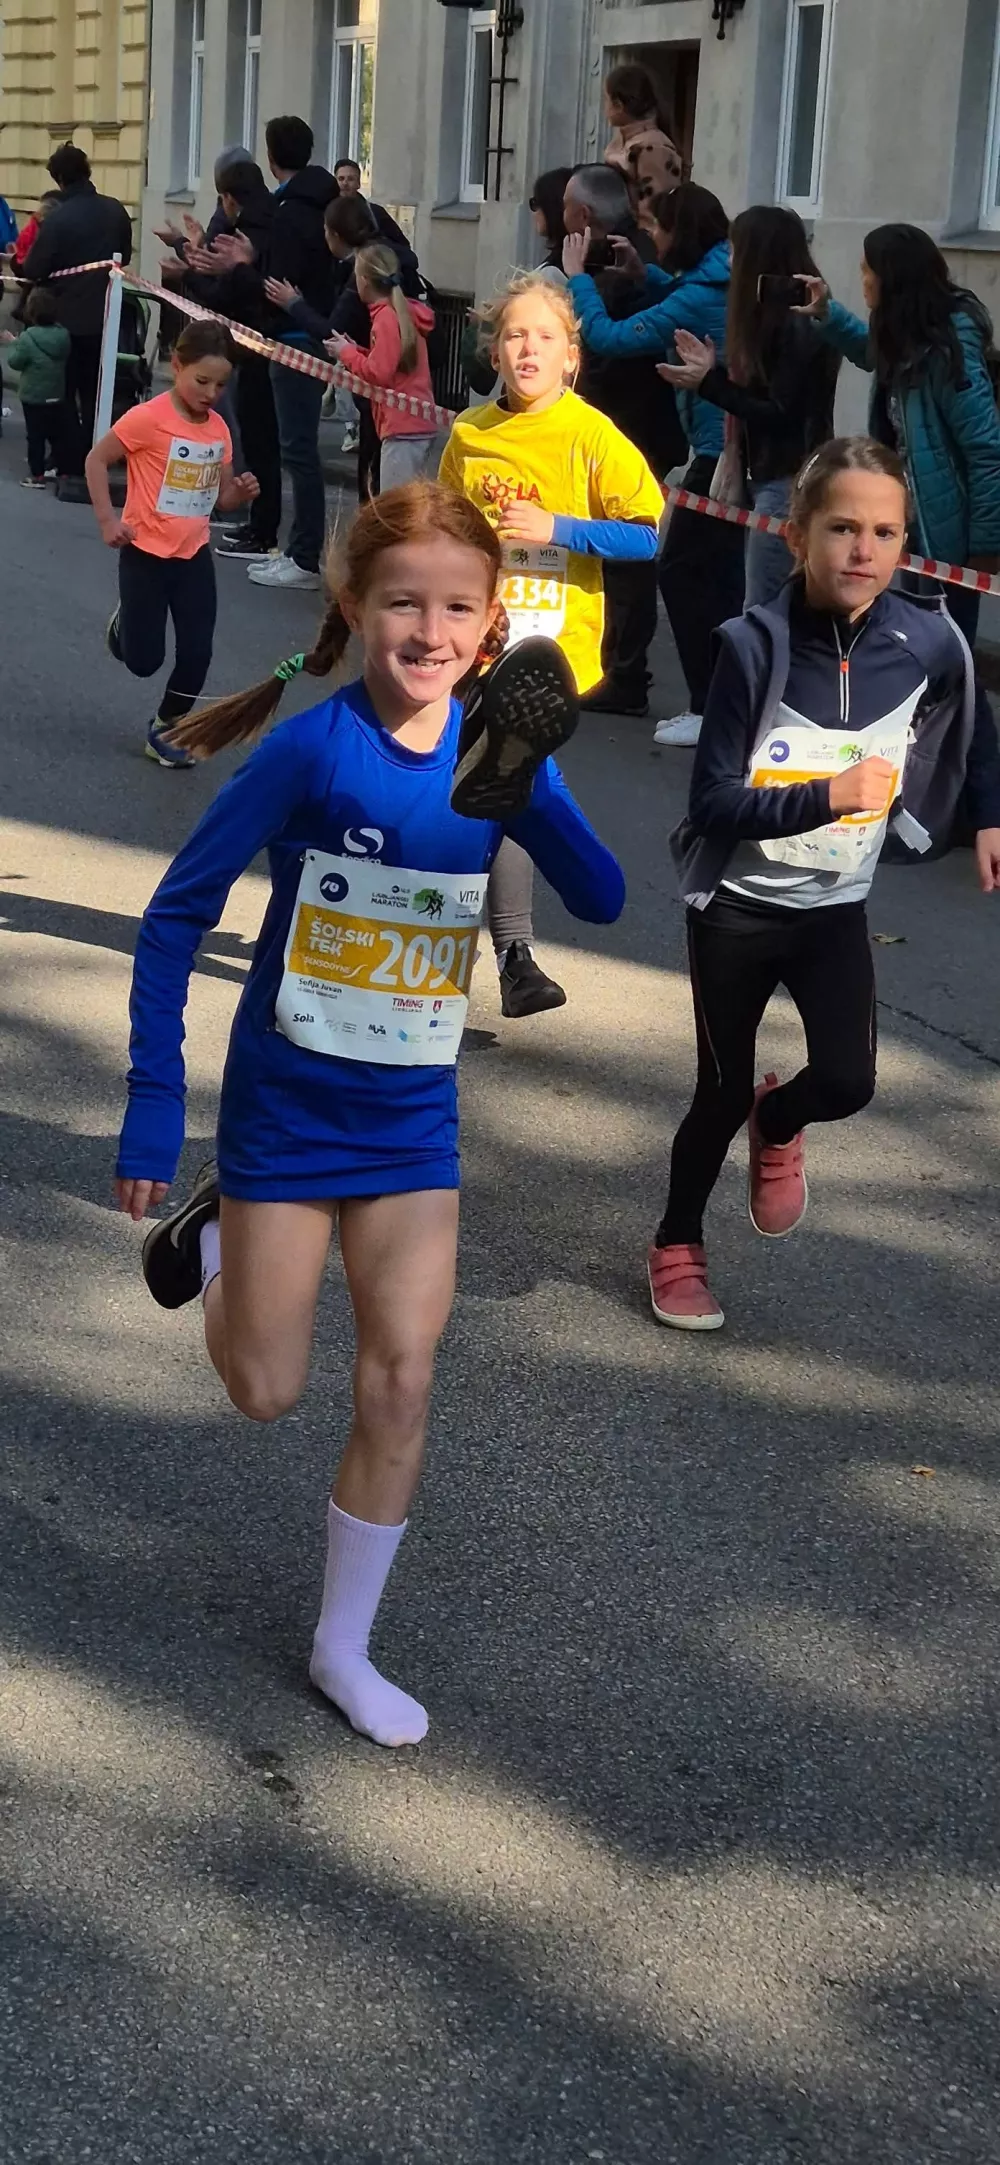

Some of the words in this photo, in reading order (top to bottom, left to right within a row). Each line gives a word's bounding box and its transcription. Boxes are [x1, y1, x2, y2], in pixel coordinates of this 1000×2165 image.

[540, 548, 559, 558] VITA
[371, 897, 408, 909] MARATON
[459, 890, 480, 903] VITA
[310, 914, 376, 948] ŠOLSKI
[308, 935, 344, 958] TEK
[303, 956, 354, 975] SENSODYNE
[369, 929, 472, 990] 2091
[298, 977, 320, 989] Sofija
[320, 983, 343, 994] Juvan
[392, 997, 424, 1009] TIMING
[292, 1012, 315, 1023] Sola
